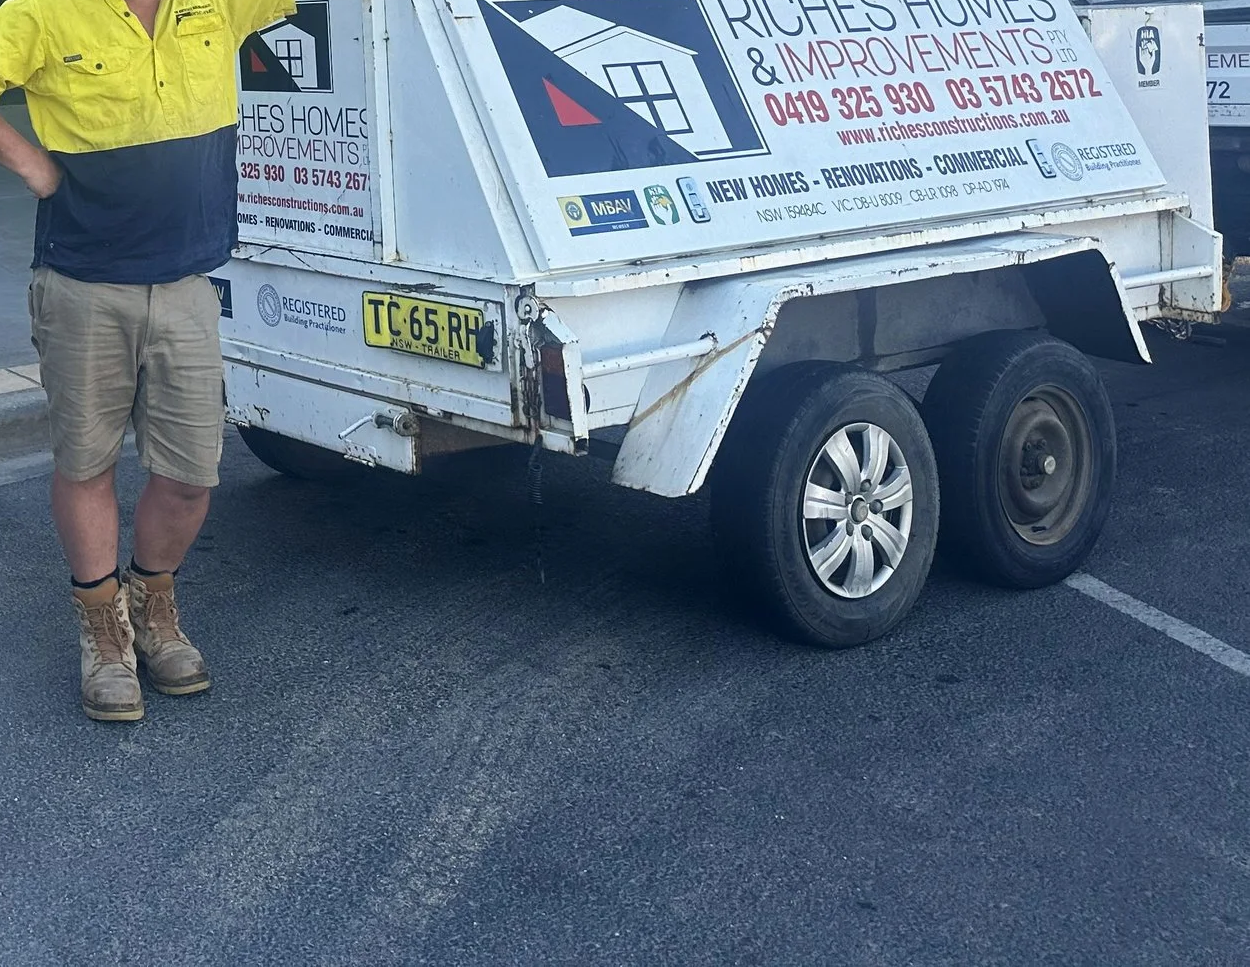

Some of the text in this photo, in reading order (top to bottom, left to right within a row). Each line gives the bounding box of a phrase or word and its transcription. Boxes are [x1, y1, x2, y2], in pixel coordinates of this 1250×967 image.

[1046, 30, 1068, 44] PTY
[775, 27, 1053, 83] IMPROVEMENTS
[1056, 48, 1078, 62] LTD
[1138, 79, 1160, 88] MEMBER
[764, 67, 1102, 127] 0419 325 930 03 5743 2672
[837, 107, 1071, 145] www.richesconstructions.com.au
[1076, 142, 1137, 161] REGISTERED
[240, 161, 370, 191] 325 930 03 5743 267
[706, 178, 748, 204] NEW
[748, 171, 810, 199] HOMES
[820, 157, 923, 190] RENOVATIONS
[933, 146, 1028, 176] COMMERCIAL
[1084, 158, 1142, 172] Building Practitioner
[854, 194, 878, 210] DB-U
[879, 191, 902, 206] 8009
[909, 187, 938, 203] CB-LR
[938, 184, 958, 199] 1098
[963, 180, 992, 195] DP-AD
[992, 177, 1010, 192] 1974
[591, 197, 631, 216] MBAV
[238, 213, 257, 225] OMES
[265, 216, 316, 234] RENOVATIONS
[282, 296, 346, 322] REGISTERED
[284, 313, 308, 328] Building
[392, 338, 412, 350] NSW
[422, 343, 461, 361] TRAILER
